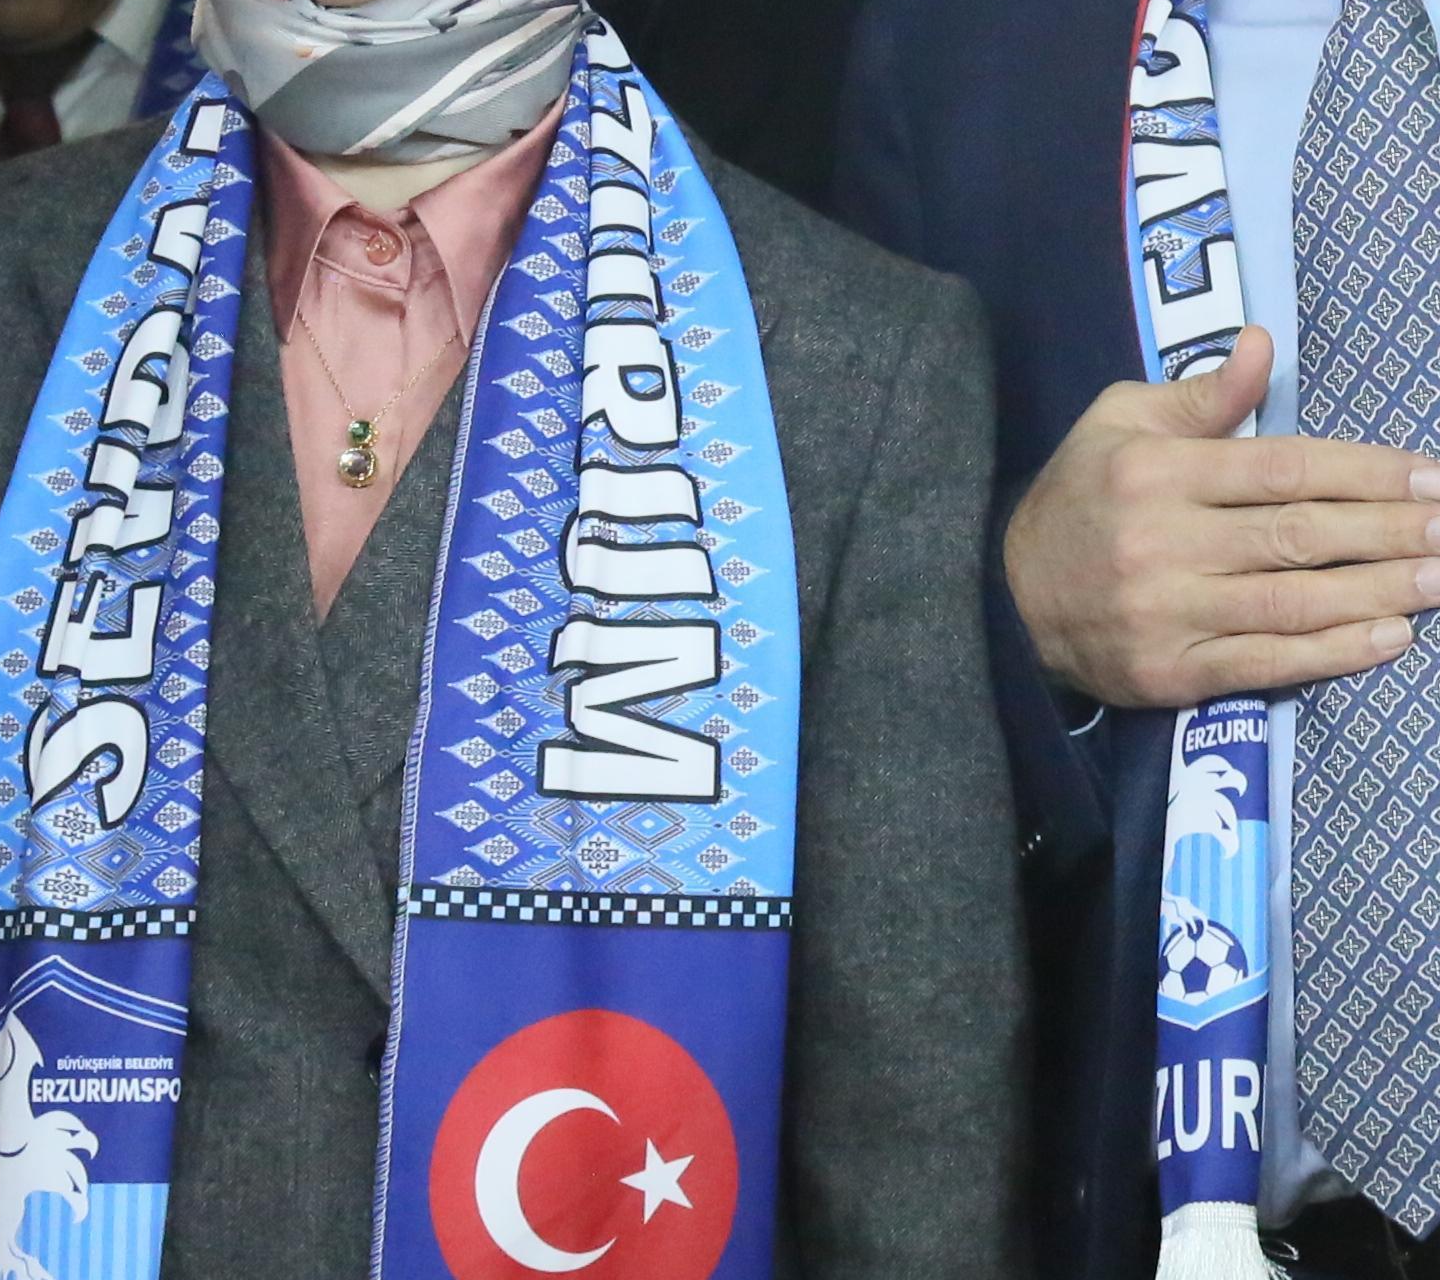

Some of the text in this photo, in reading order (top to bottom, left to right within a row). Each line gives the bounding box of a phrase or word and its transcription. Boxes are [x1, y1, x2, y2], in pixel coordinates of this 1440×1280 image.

[1184, 718, 1268, 753] ERZURU
[56, 1055, 123, 1073] BÜYÜKŞEHİR
[1156, 1058, 1267, 1161] ZUR
